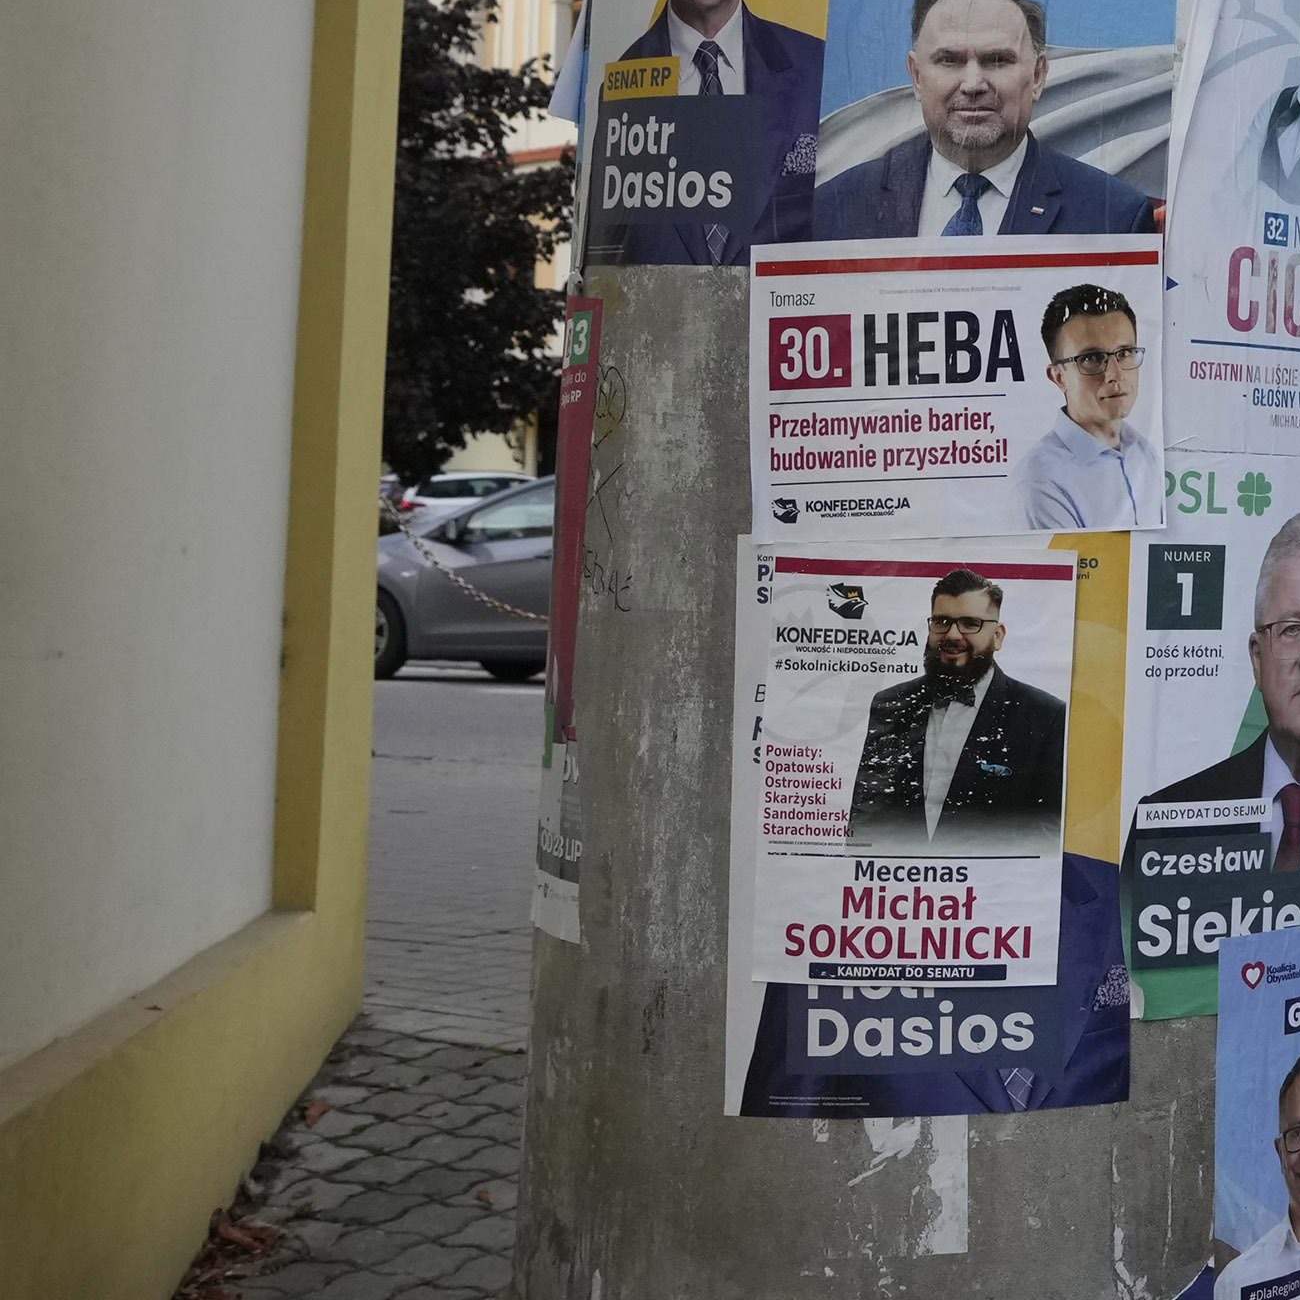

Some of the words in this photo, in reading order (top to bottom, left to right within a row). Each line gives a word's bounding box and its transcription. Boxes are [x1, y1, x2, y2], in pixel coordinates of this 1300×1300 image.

[607, 67, 647, 92] SENAT
[650, 66, 672, 88] RP
[606, 112, 675, 157] Piotr
[602, 156, 733, 210] Dasios
[1266, 216, 1287, 242] 32.
[770, 290, 815, 308] Tomasz
[779, 326, 844, 381] 30.
[863, 309, 1025, 387] HEBA
[574, 369, 587, 383] do
[1190, 361, 1243, 382] OSTATNI
[1246, 364, 1261, 384] NA
[1265, 363, 1298, 387] LIŚCIE
[571, 390, 582, 403] RP
[1253, 386, 1296, 409] GŁOŚNY
[769, 410, 923, 440] Przełamywanie
[928, 406, 995, 435] barier,
[770, 442, 877, 472] budowanie
[882, 438, 1008, 472] przyszłości!
[805, 497, 911, 513] KONFEDERACJA
[820, 510, 847, 519] WOLNOŚĆ
[1163, 551, 1212, 563] NUMER
[1176, 572, 1194, 617] 1
[776, 626, 919, 647] KONFEDERACJA
[795, 645, 832, 655] WOLNOŚĆ
[837, 645, 897, 656] NIEPODLEGŁOŚĆ
[1145, 645, 1180, 659] Dość
[1182, 645, 1225, 660] kłótni,
[775, 659, 919, 675] #SokolnickiDoSenatu
[1145, 665, 1162, 678] do
[1164, 663, 1219, 681] przodu!
[766, 745, 823, 761] Powiaty:
[765, 759, 834, 775] Opatowski
[765, 775, 842, 791] Ostrowiecki
[764, 791, 827, 807] Skarżyski
[1145, 807, 1211, 822] KANDYDAT
[1213, 806, 1231, 818] DO
[1233, 804, 1267, 817] SEJMU
[1140, 846, 1265, 877] Czesław
[854, 860, 968, 883] Mecenas
[841, 886, 977, 921] Michał
[784, 922, 1032, 960] SOKOLNICKI
[837, 966, 902, 978] KANDYDAT
[905, 967, 924, 979] DO
[926, 967, 976, 979] SENATU
[1266, 962, 1297, 975] Koalicja
[806, 1000, 1036, 1058] Dasios
